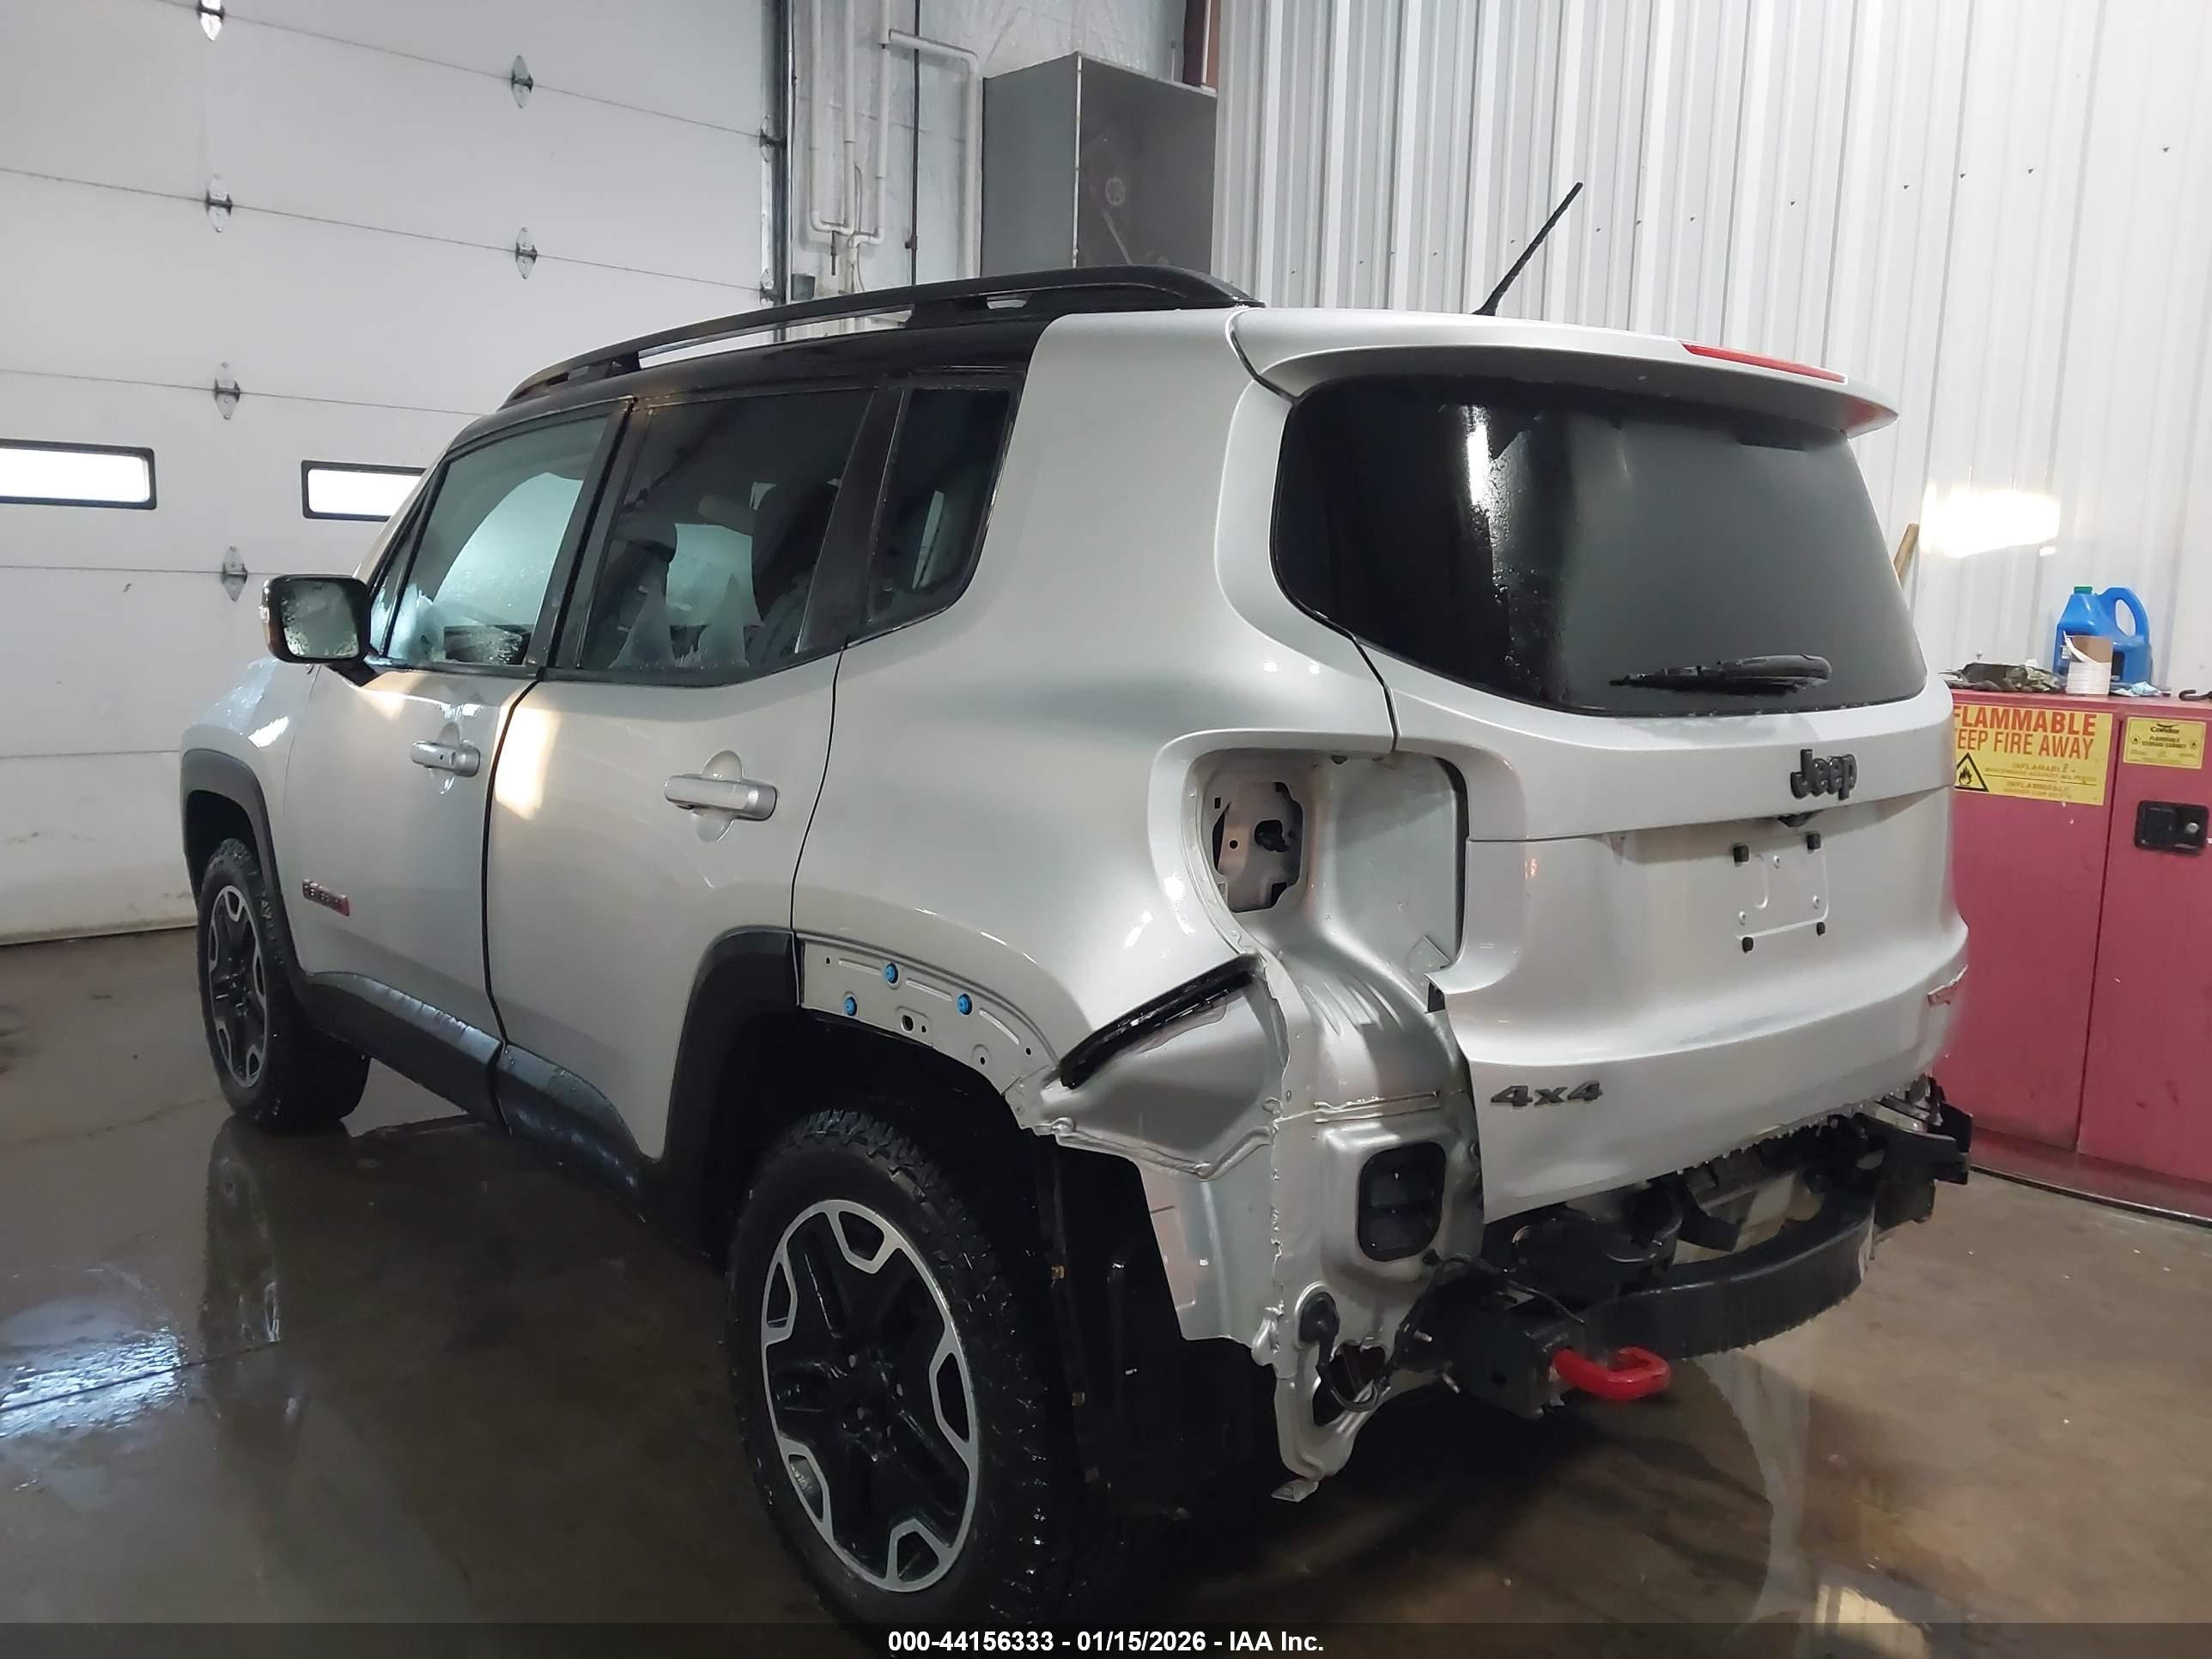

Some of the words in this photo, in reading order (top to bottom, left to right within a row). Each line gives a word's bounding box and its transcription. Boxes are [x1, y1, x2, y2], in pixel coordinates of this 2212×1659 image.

[1955, 727, 1989, 750] EEP
[1994, 731, 2033, 755] FIRE
[2039, 734, 2094, 760] AWAY
[1790, 749, 1857, 800] Jeep
[1490, 1079, 1603, 1107] 4x4
